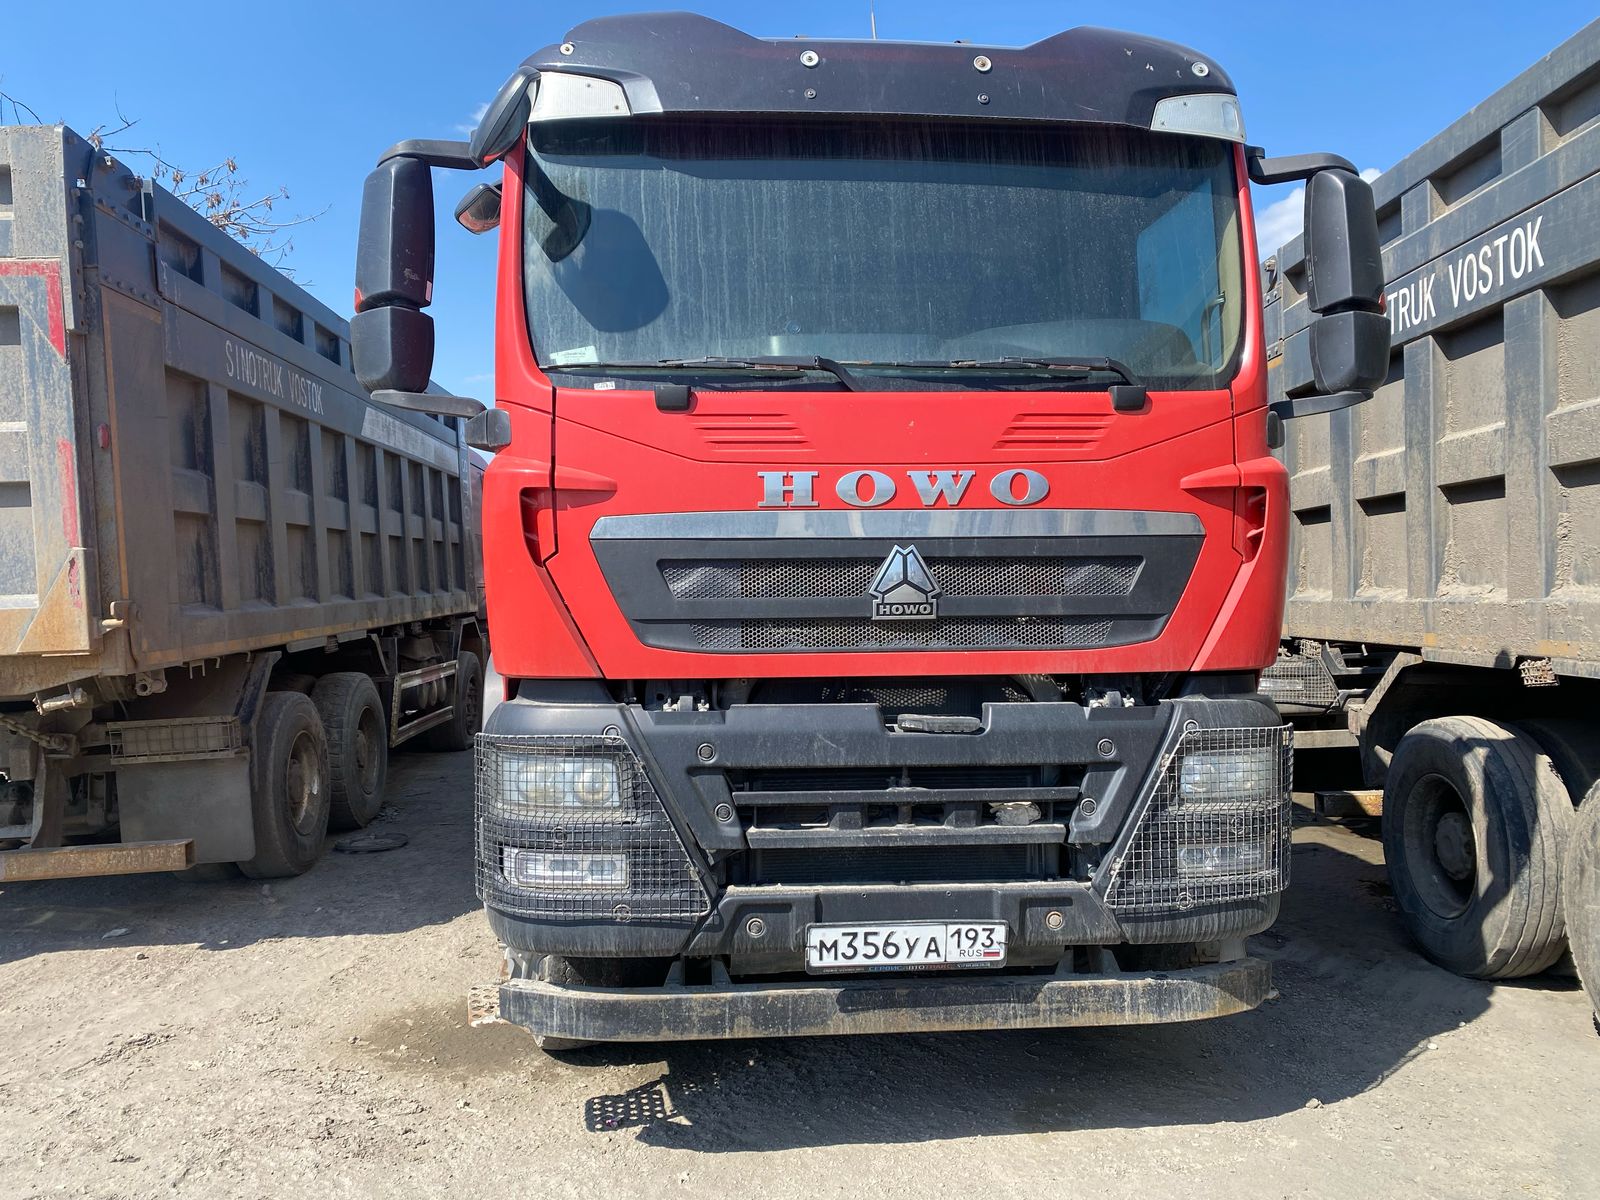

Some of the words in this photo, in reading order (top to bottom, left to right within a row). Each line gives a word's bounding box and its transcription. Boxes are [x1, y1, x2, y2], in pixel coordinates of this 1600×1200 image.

[1384, 272, 1437, 335] TRUK
[1448, 215, 1545, 309] VOSTOK
[225, 339, 284, 399] SINOTRUK
[287, 369, 324, 415] VOSTOK
[757, 468, 1050, 507] HOWO
[879, 603, 932, 615] HOWO
[950, 927, 996, 949] 193
[959, 948, 982, 958] RUS
